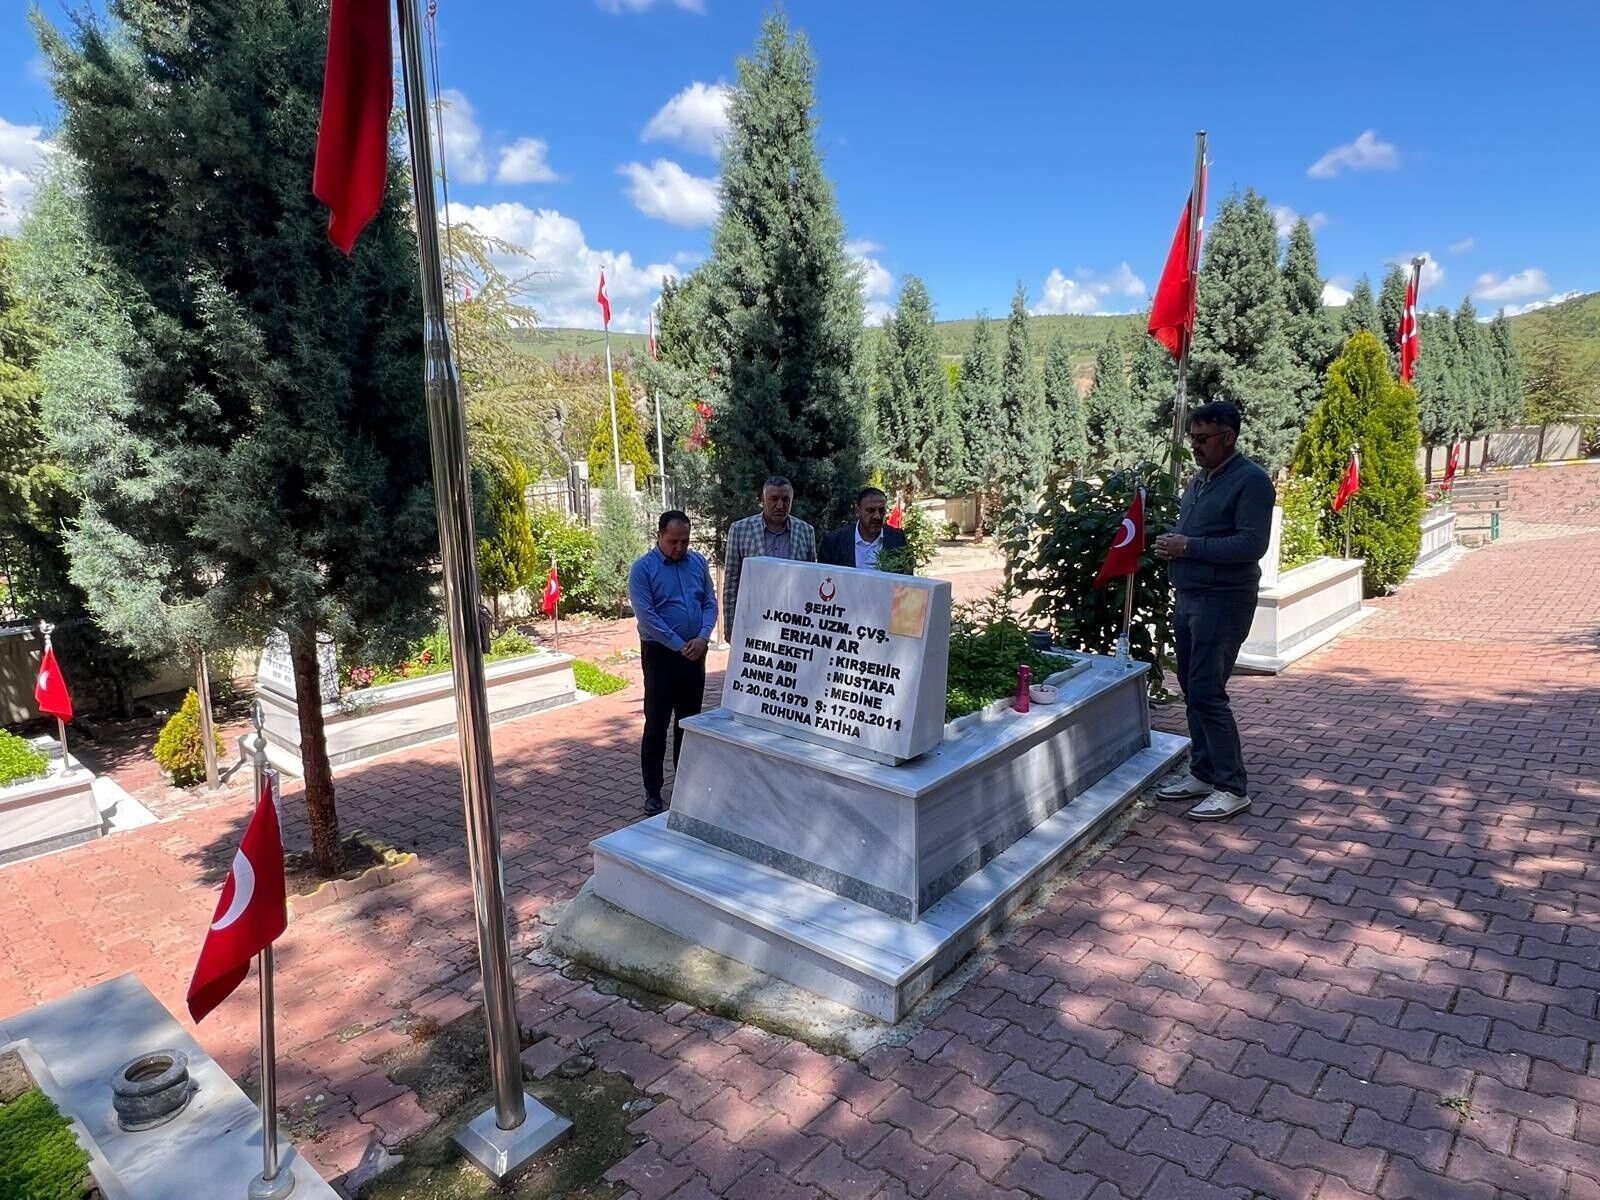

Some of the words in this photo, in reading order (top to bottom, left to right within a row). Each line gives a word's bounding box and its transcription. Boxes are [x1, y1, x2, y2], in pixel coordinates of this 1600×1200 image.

[804, 601, 846, 618] ŞEHİT
[762, 609, 814, 628] J.KOMD.
[819, 618, 852, 635] UZM.
[856, 625, 889, 643] ÇVŞ.
[745, 637, 814, 661] MEMLEKETİ
[780, 627, 832, 649] ERHAN
[836, 638, 860, 655] AR
[742, 652, 773, 669] BABA
[741, 667, 774, 684] ANNE
[775, 675, 797, 689] ADI
[732, 680, 744, 692] D:
[745, 683, 809, 708] 20.06.1979
[831, 704, 902, 732] 17.08.2011
[760, 702, 811, 725] RUHUNA
[815, 717, 861, 738] FATİHA
